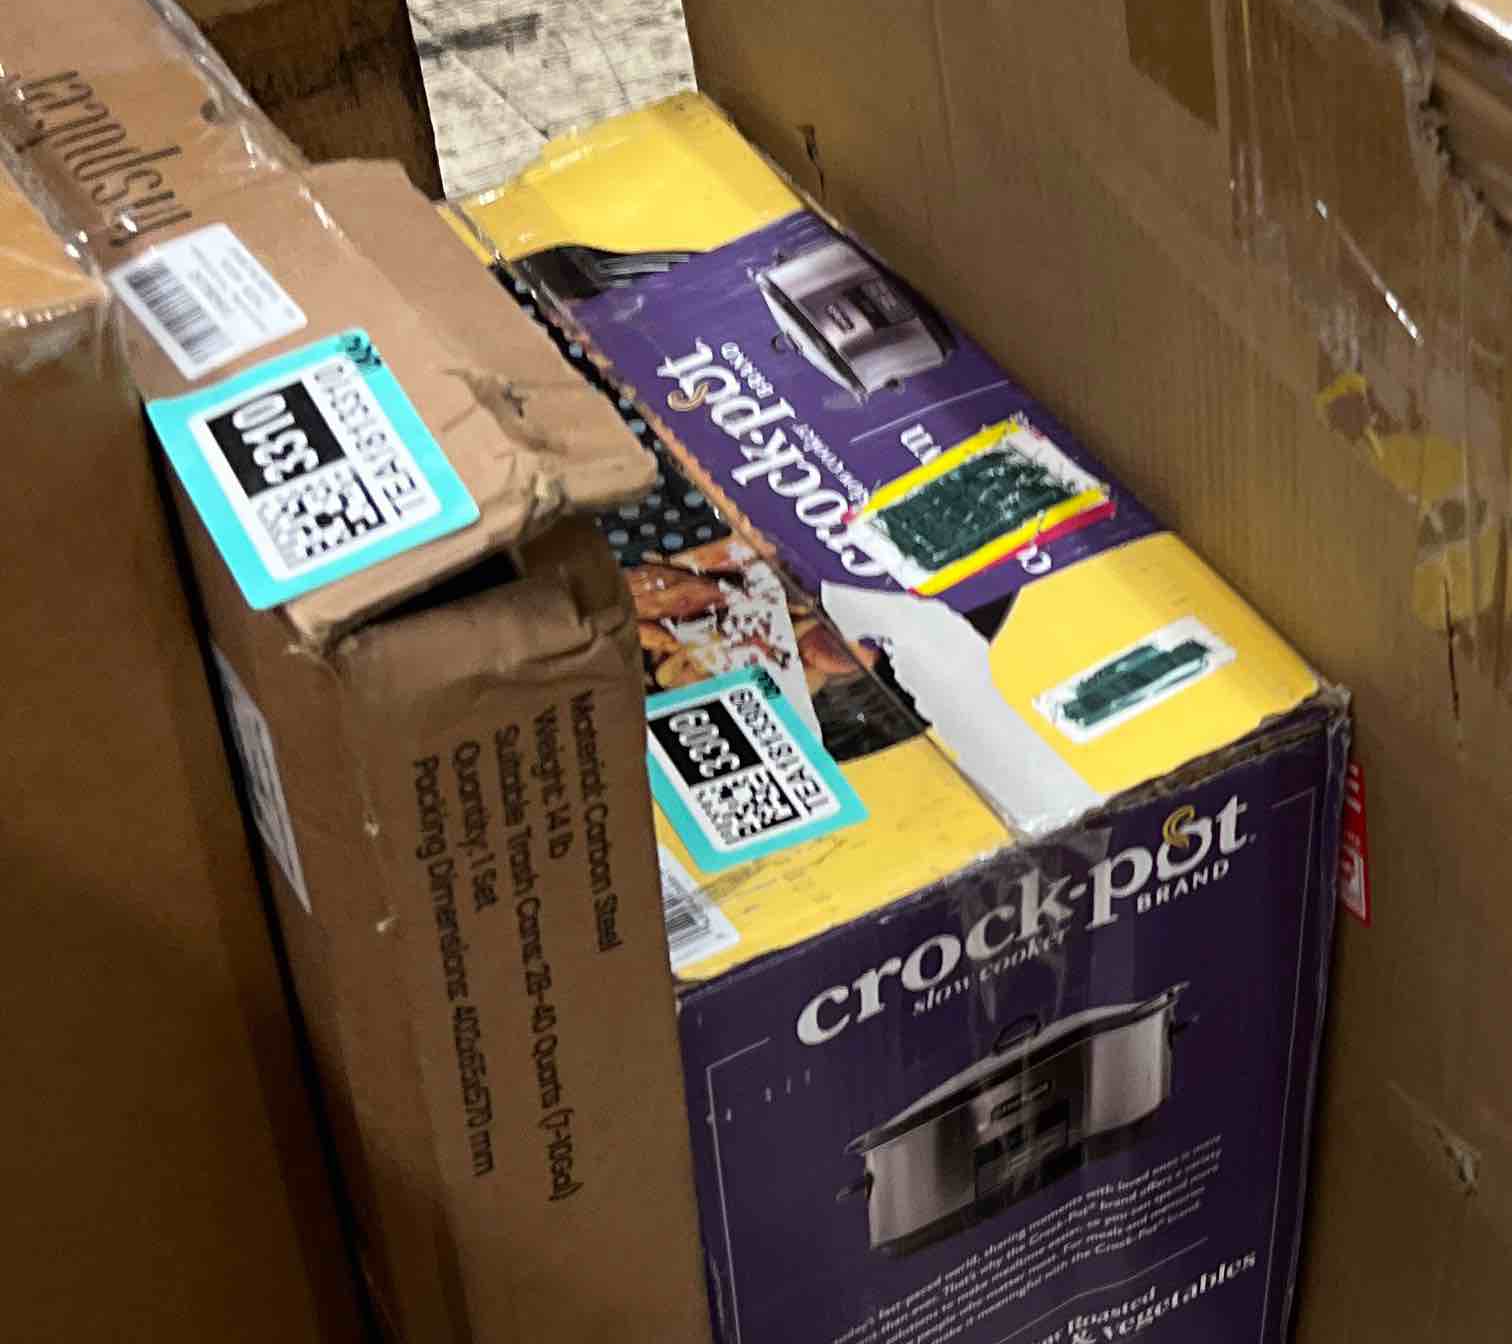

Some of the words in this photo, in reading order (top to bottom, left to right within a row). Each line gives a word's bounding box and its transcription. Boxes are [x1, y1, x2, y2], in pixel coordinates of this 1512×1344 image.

[231, 393, 320, 485] 3310
[495, 723, 530, 827] Suitable
[668, 708, 742, 779] 3309
[413, 752, 448, 860] Packing
[584, 802, 613, 894] Carbon
[504, 825, 540, 896] Trash
[1135, 860, 1231, 914] BRAND
[795, 794, 1250, 1048] crock-pot
[912, 977, 970, 1017] slow
[979, 926, 1072, 984] cooker
[529, 1033, 562, 1111] Quarts
[1067, 1285, 1157, 1337] Roasted
